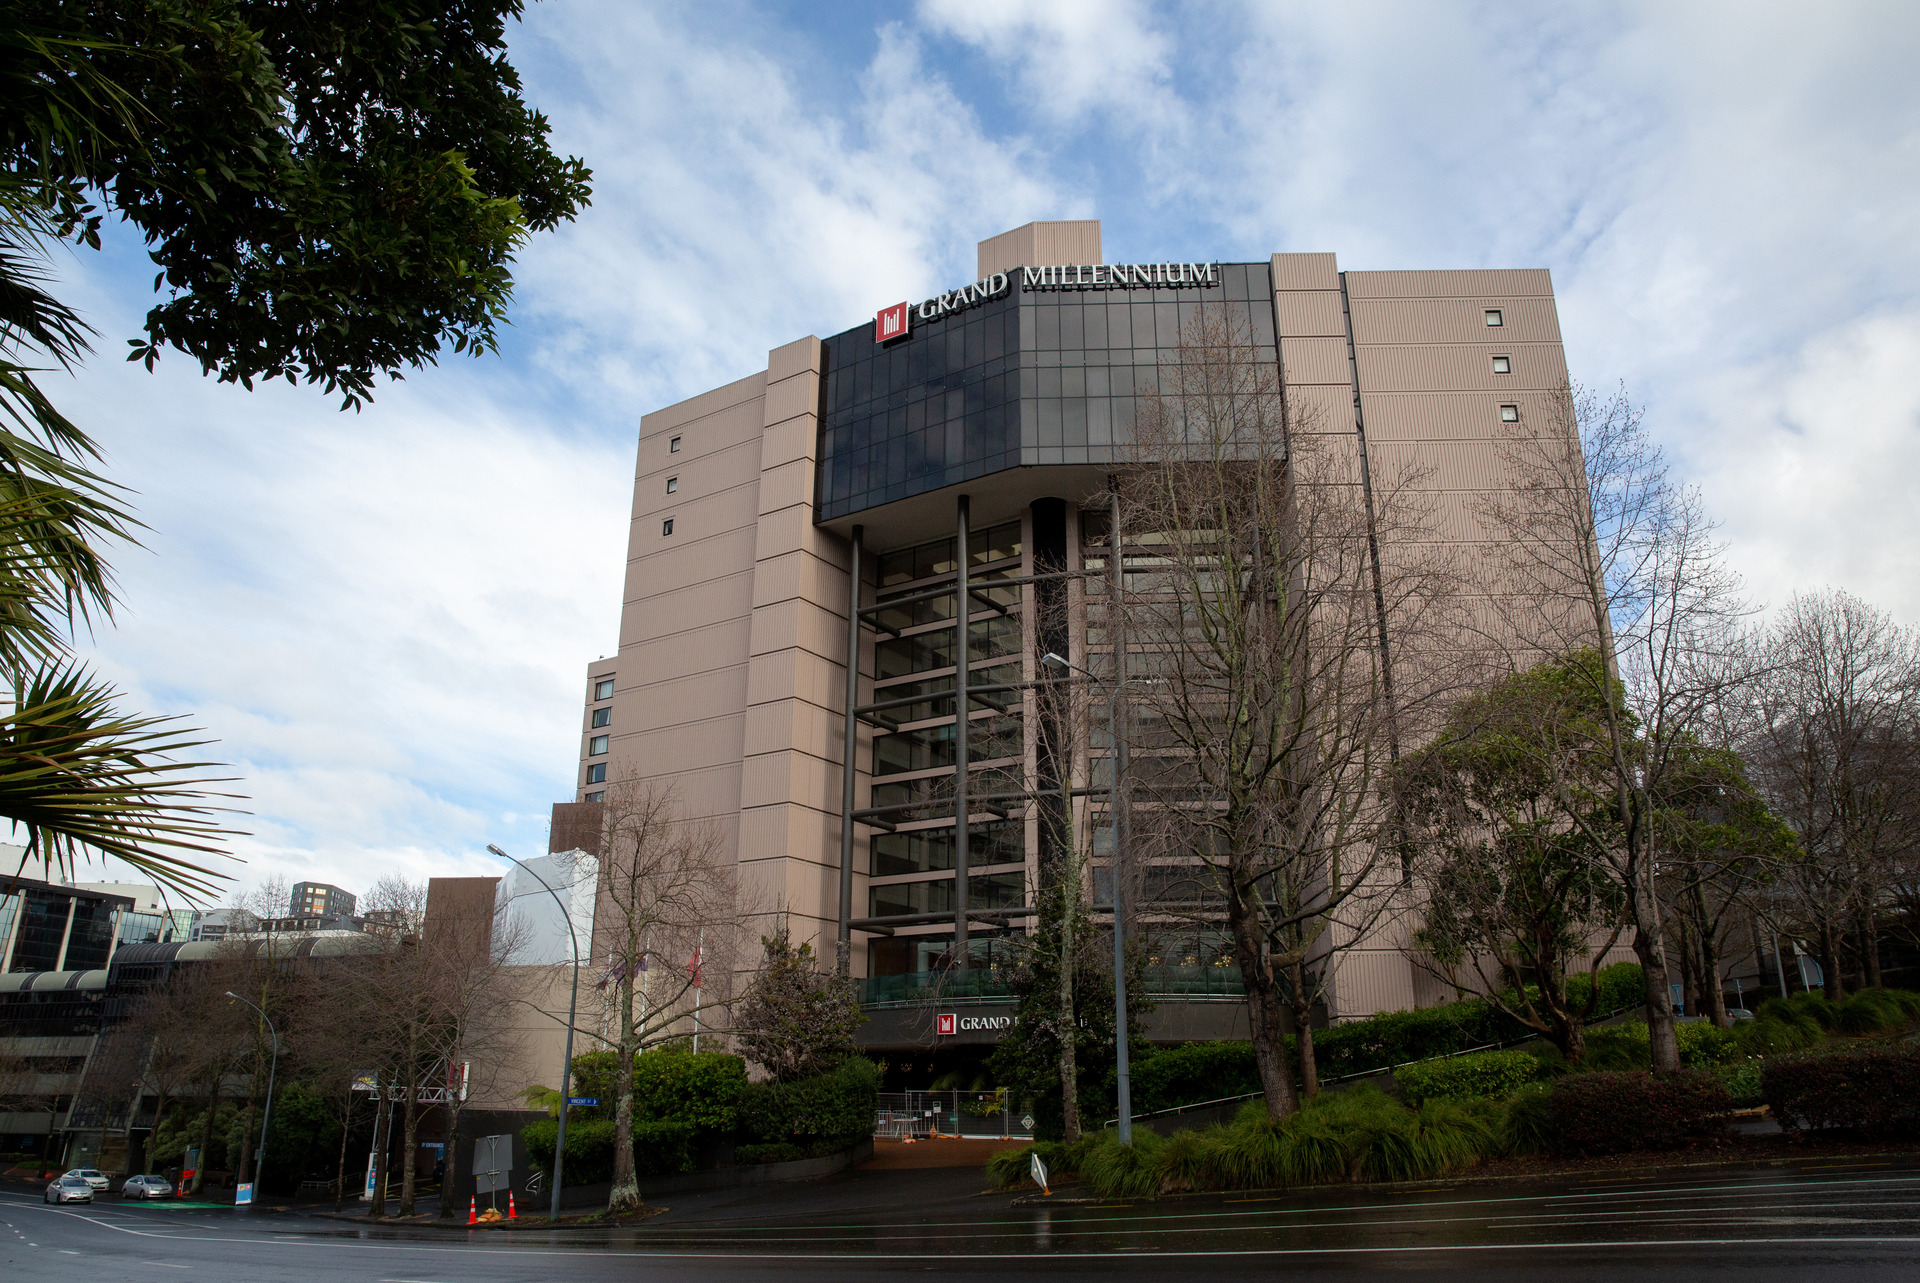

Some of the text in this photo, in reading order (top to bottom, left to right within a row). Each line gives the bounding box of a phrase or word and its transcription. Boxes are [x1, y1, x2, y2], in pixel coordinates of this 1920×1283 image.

[919, 262, 1213, 319] GRAND MILLENNIUM
[960, 1016, 1010, 1030] GRAND
